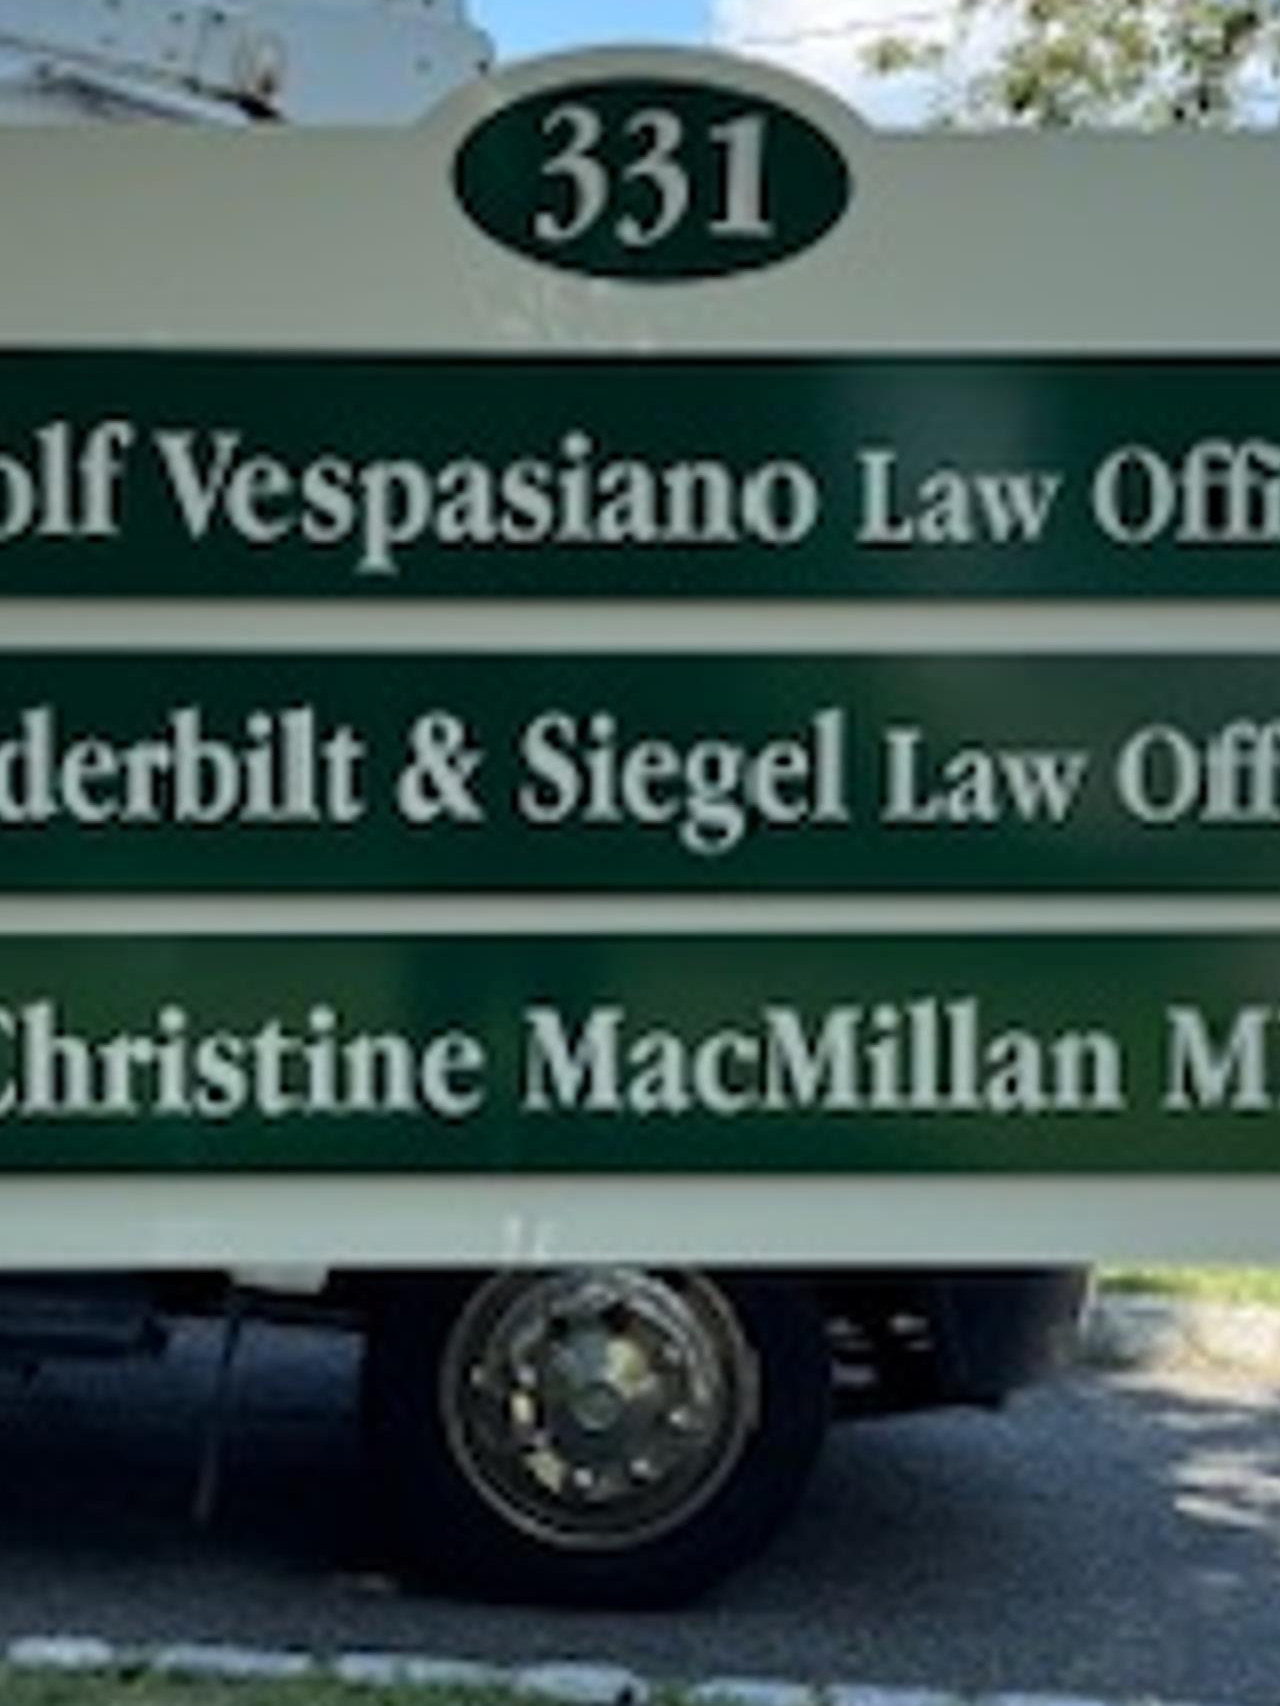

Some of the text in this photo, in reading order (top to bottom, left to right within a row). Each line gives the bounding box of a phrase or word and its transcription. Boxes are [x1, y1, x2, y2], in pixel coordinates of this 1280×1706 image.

[533, 105, 774, 246] 331
[159, 434, 817, 570] Vespasiano
[861, 450, 1056, 542] Law
[396, 712, 481, 822] &
[520, 709, 846, 852] Siegel
[886, 729, 1086, 822] Law
[524, 998, 1122, 1113] MacMillan
